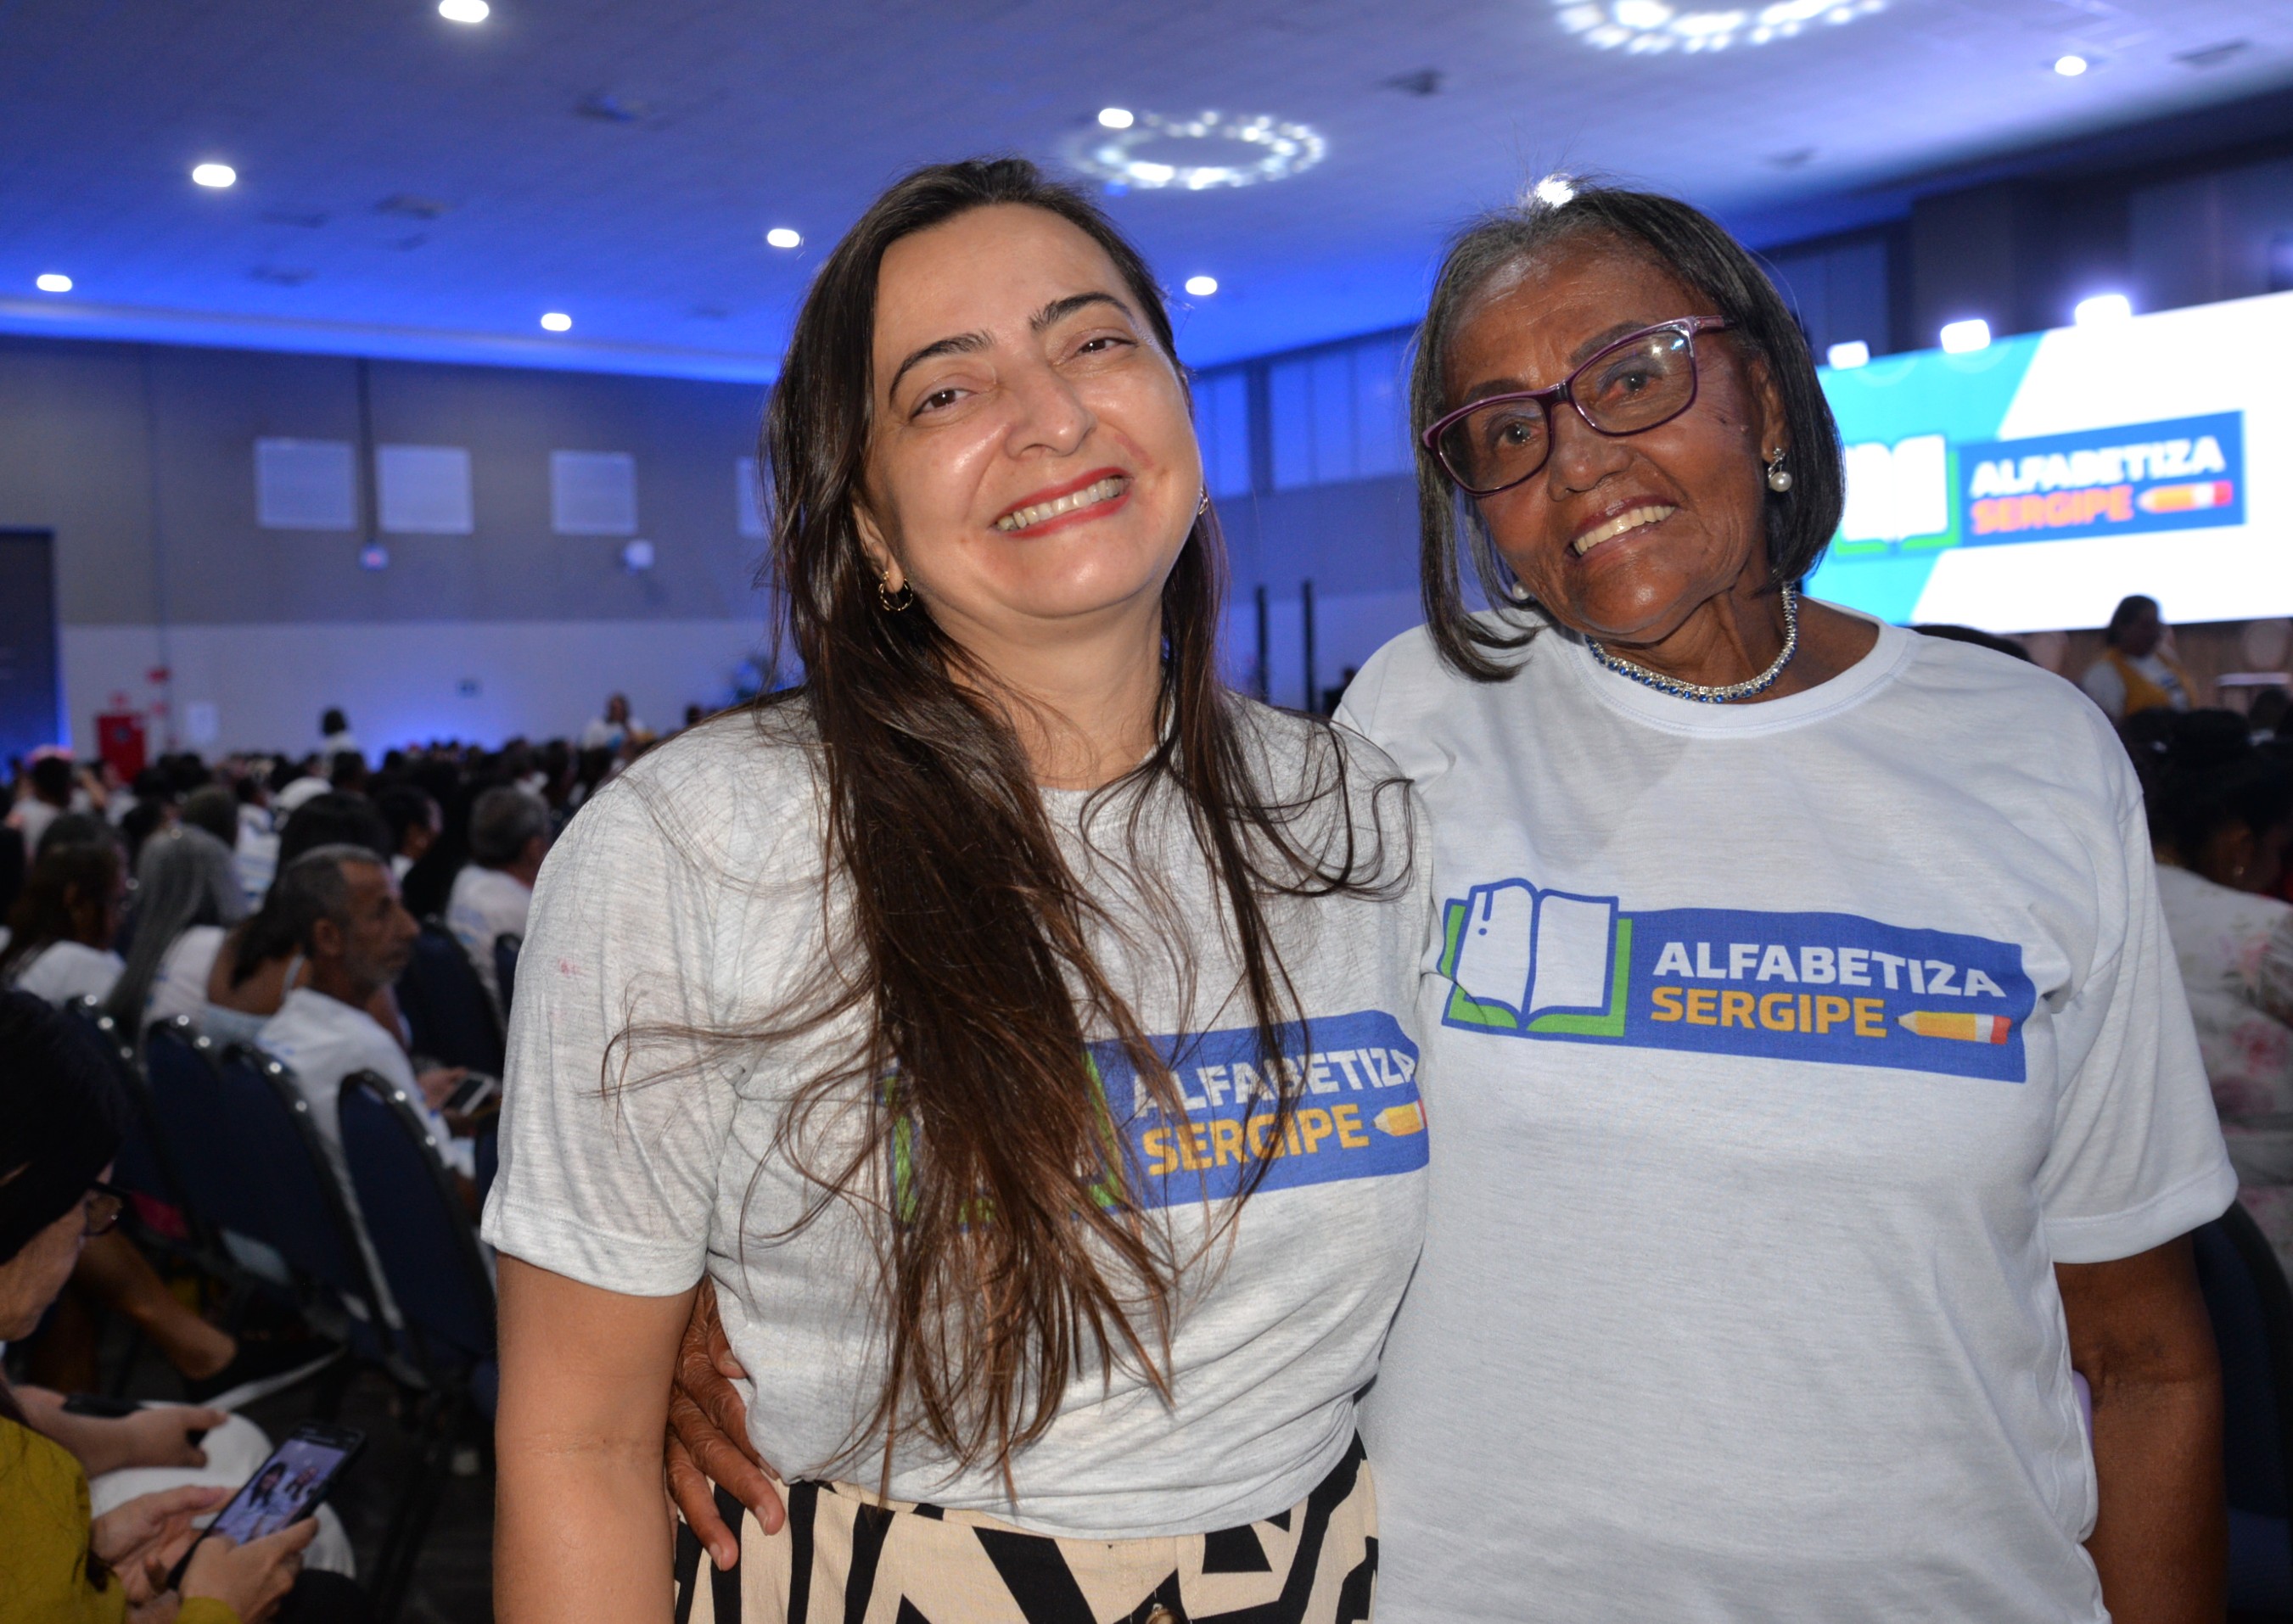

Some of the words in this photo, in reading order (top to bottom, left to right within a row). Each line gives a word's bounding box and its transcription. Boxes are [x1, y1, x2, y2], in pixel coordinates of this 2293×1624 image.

[1970, 436, 2226, 499] ALFABETIZA
[1971, 485, 2134, 535] SERGIPE
[1653, 942, 2006, 998] ALFABETIZA
[1651, 987, 1887, 1038] SERGIPE
[1142, 1104, 1369, 1175] SERGIPE
